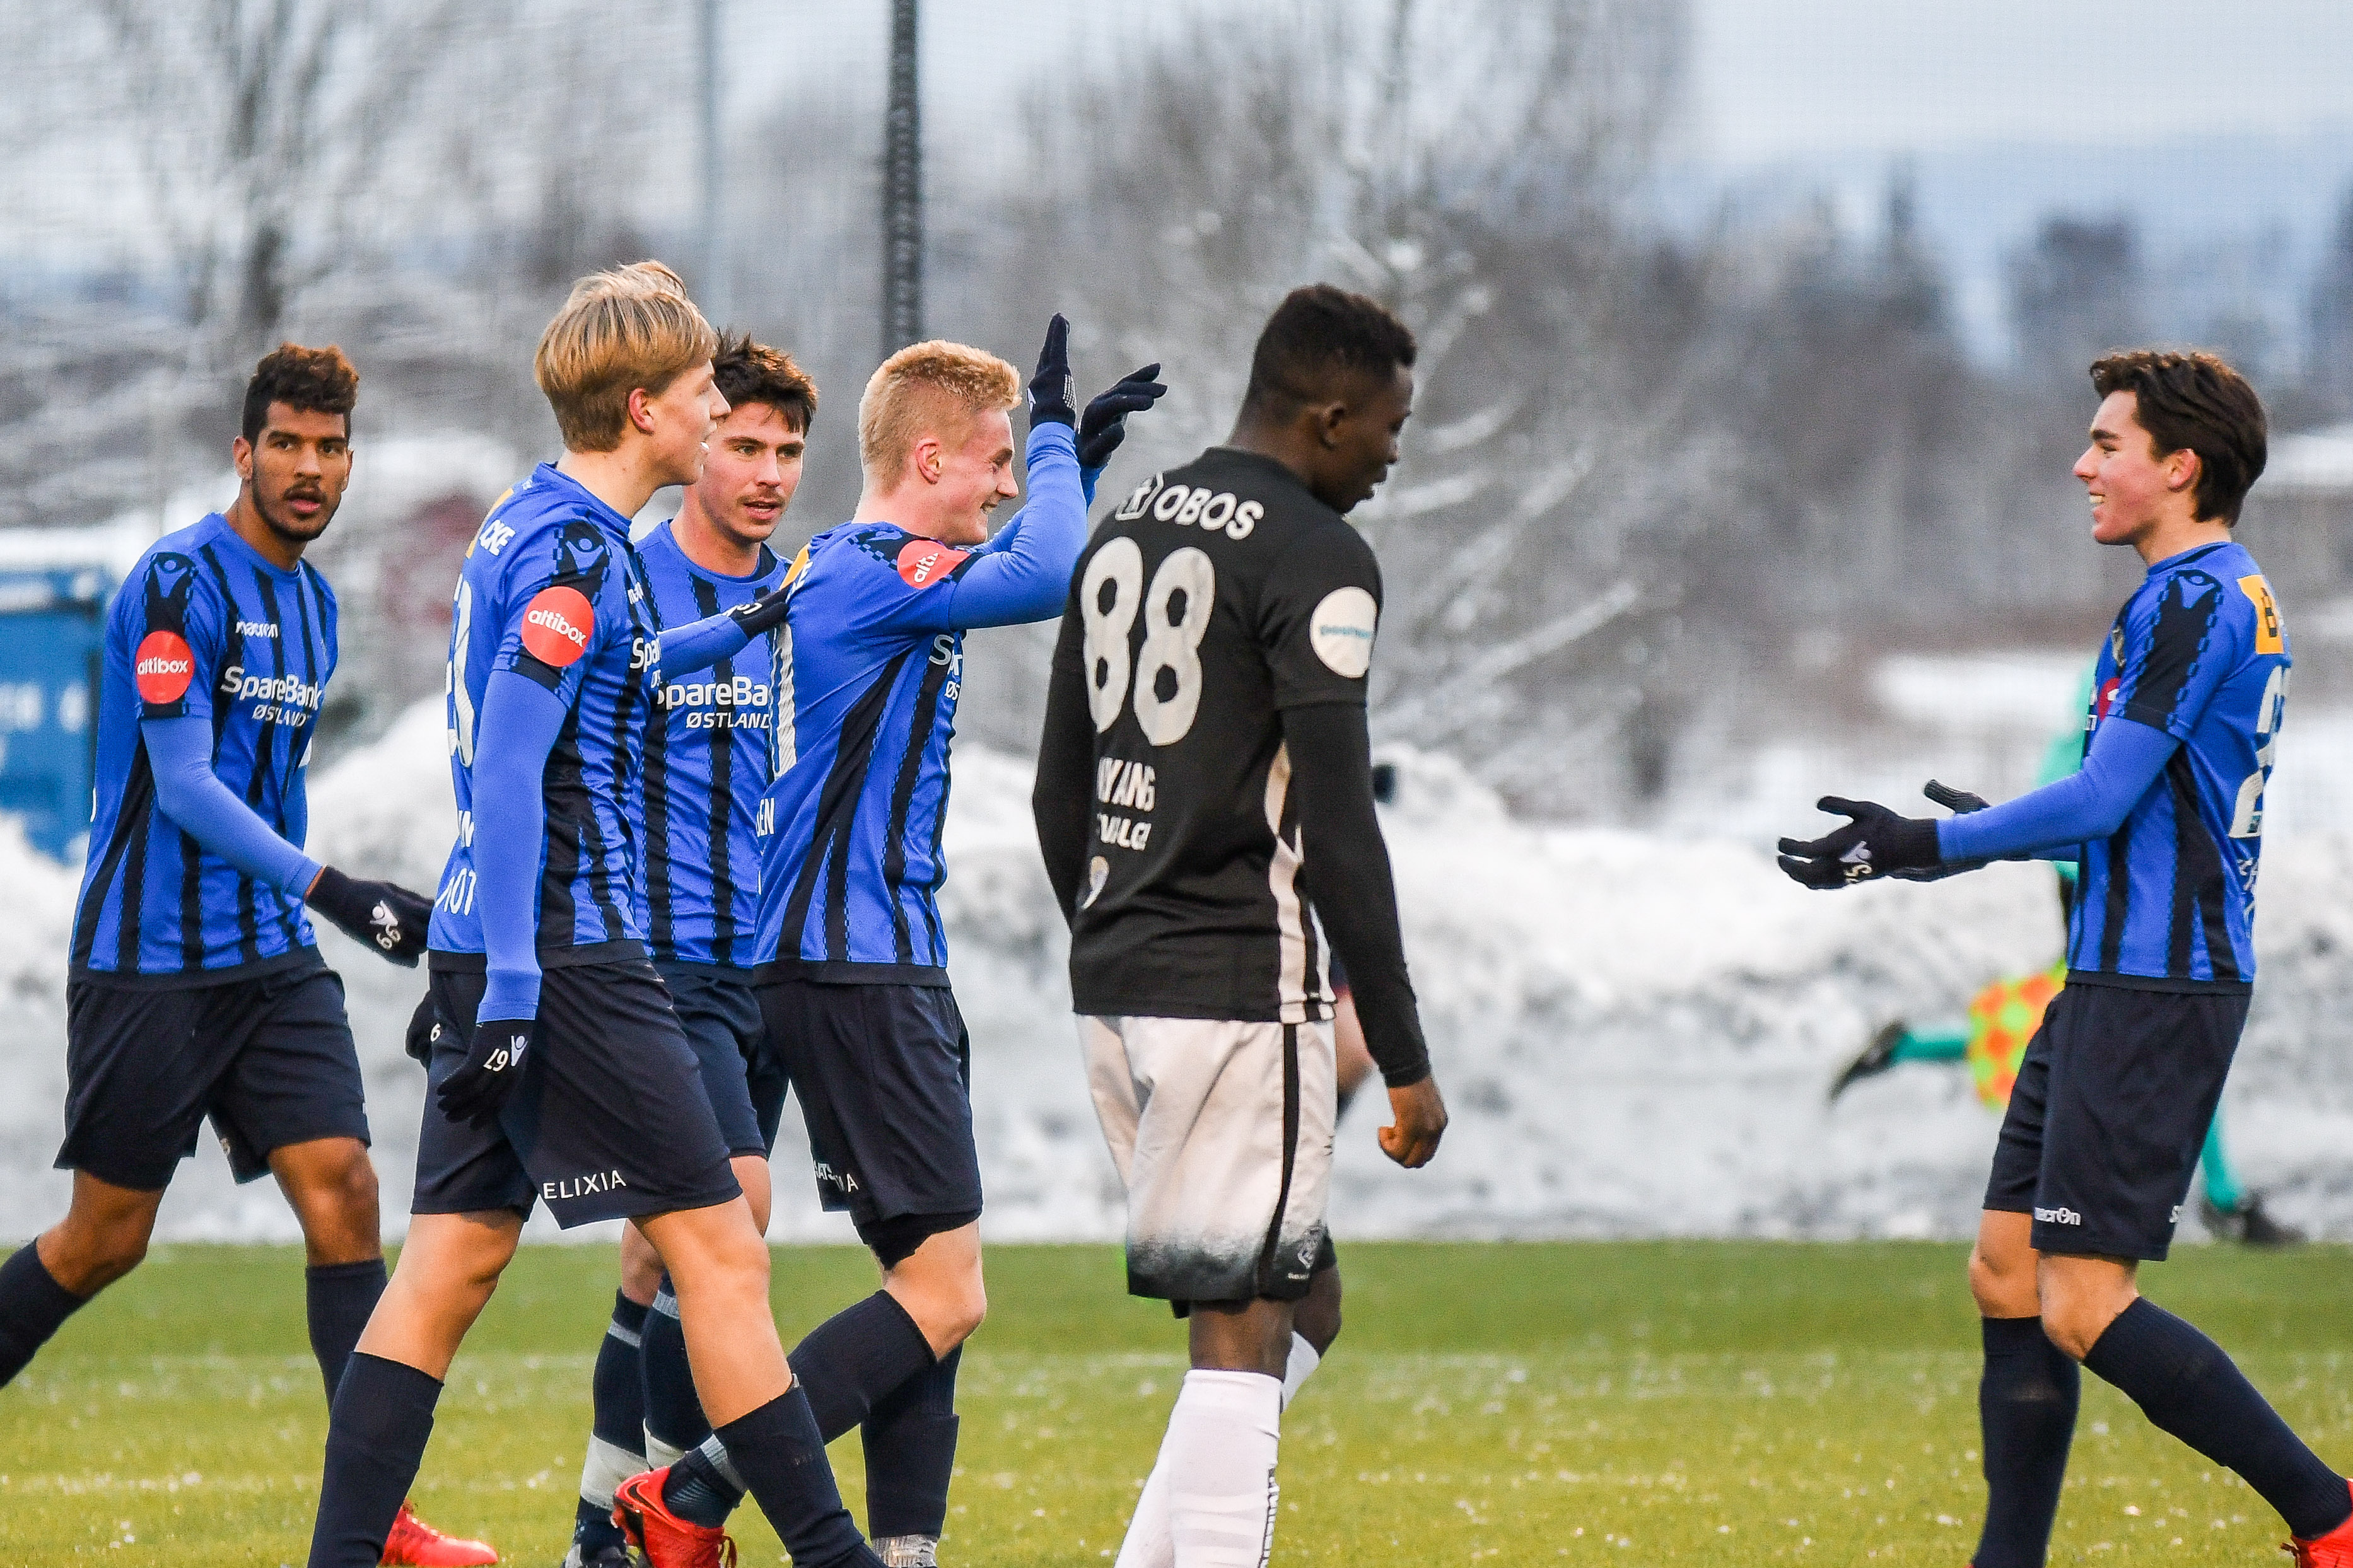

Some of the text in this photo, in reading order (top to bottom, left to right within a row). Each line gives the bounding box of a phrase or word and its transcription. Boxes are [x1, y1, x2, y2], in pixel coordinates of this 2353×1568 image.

[1153, 484, 1264, 540] OBOS
[527, 609, 587, 648] altibox
[1080, 536, 1215, 746] 88
[137, 656, 189, 677] altibox
[220, 665, 322, 711] SpareBank
[657, 676, 768, 711] pareBa
[430, 1023, 441, 1042] 6
[543, 1170, 627, 1200] ELIXIA
